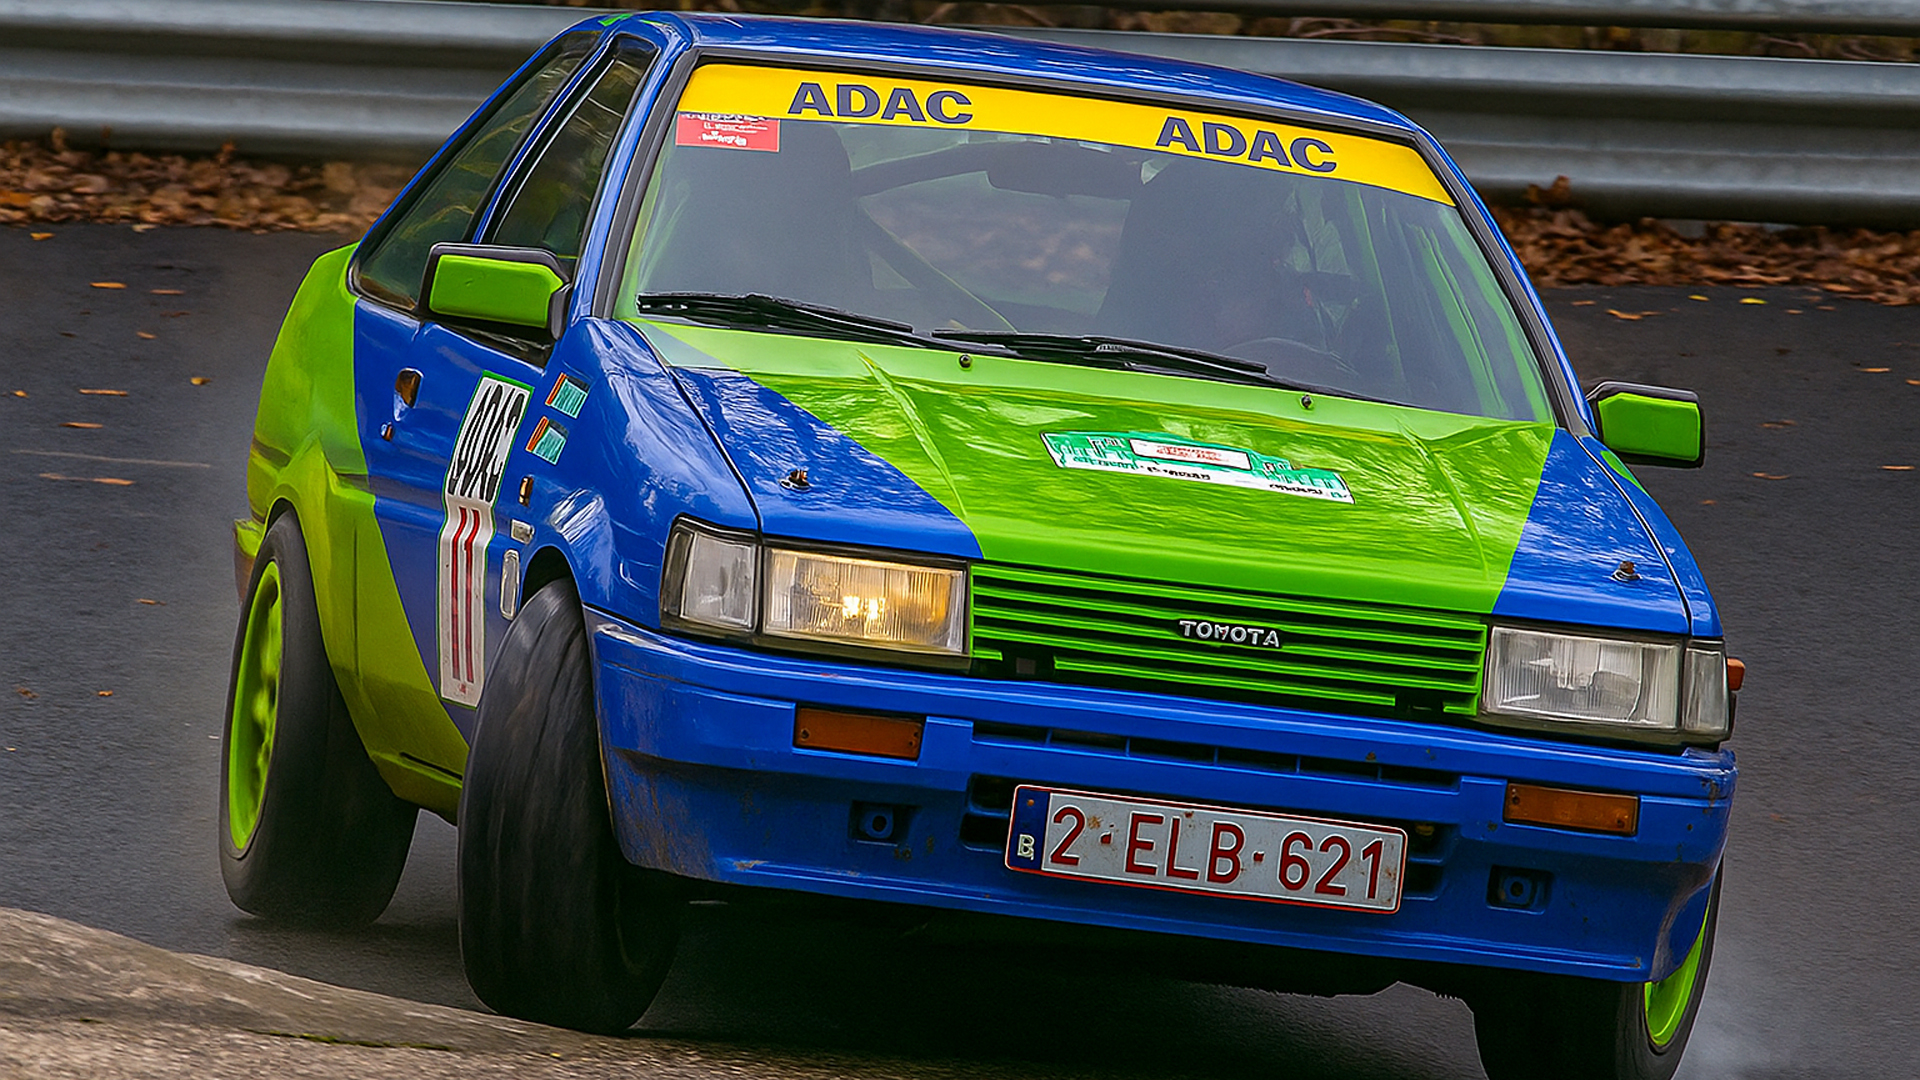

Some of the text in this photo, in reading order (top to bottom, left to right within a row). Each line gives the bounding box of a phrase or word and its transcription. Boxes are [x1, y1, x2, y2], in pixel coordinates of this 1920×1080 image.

[786, 81, 1338, 174] ADAC ADAC
[1016, 833, 1035, 862] B
